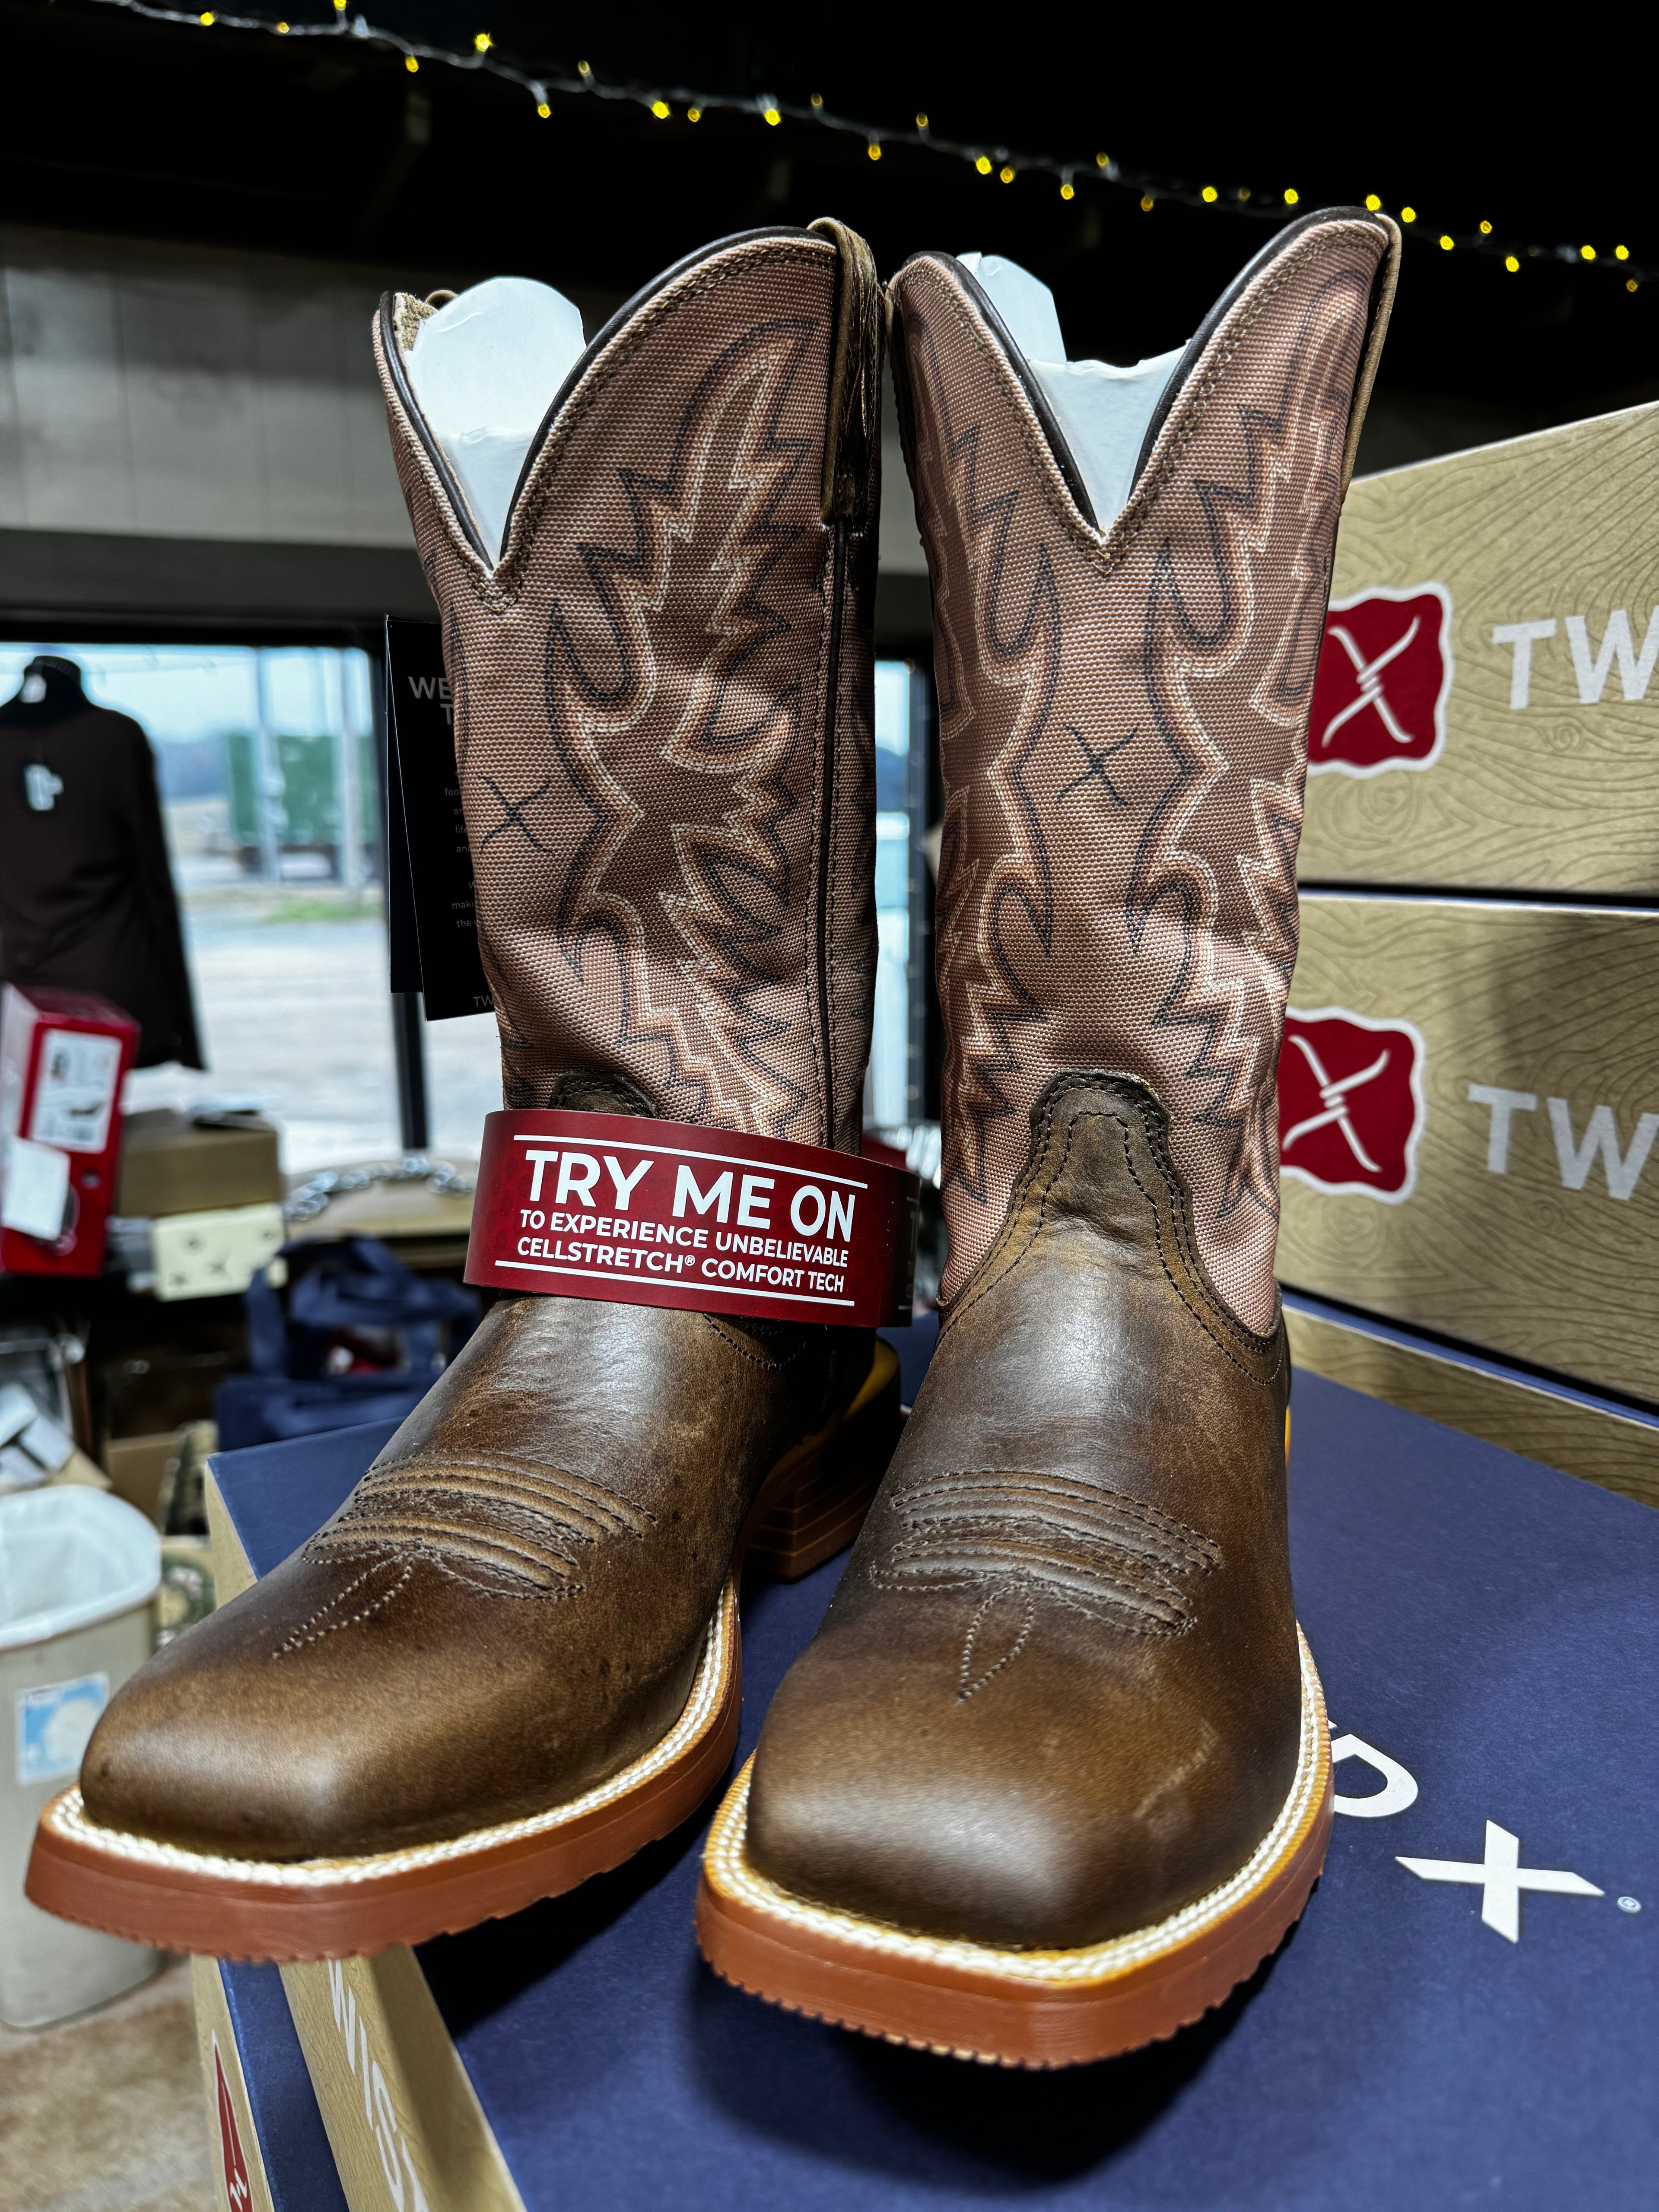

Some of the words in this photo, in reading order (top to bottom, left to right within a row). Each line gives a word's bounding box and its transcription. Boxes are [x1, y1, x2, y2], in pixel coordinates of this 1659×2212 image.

[457, 918, 472, 927] the
[525, 1150, 655, 1211] TRY
[672, 1164, 775, 1229] ME
[790, 1185, 855, 1242] ON
[520, 1209, 545, 1229] TO
[550, 1212, 709, 1249] EXPERIENCE
[715, 1231, 849, 1268] UNBELIEVABLE
[701, 1258, 805, 1287] COMFORT
[808, 1271, 844, 1293] TECH
